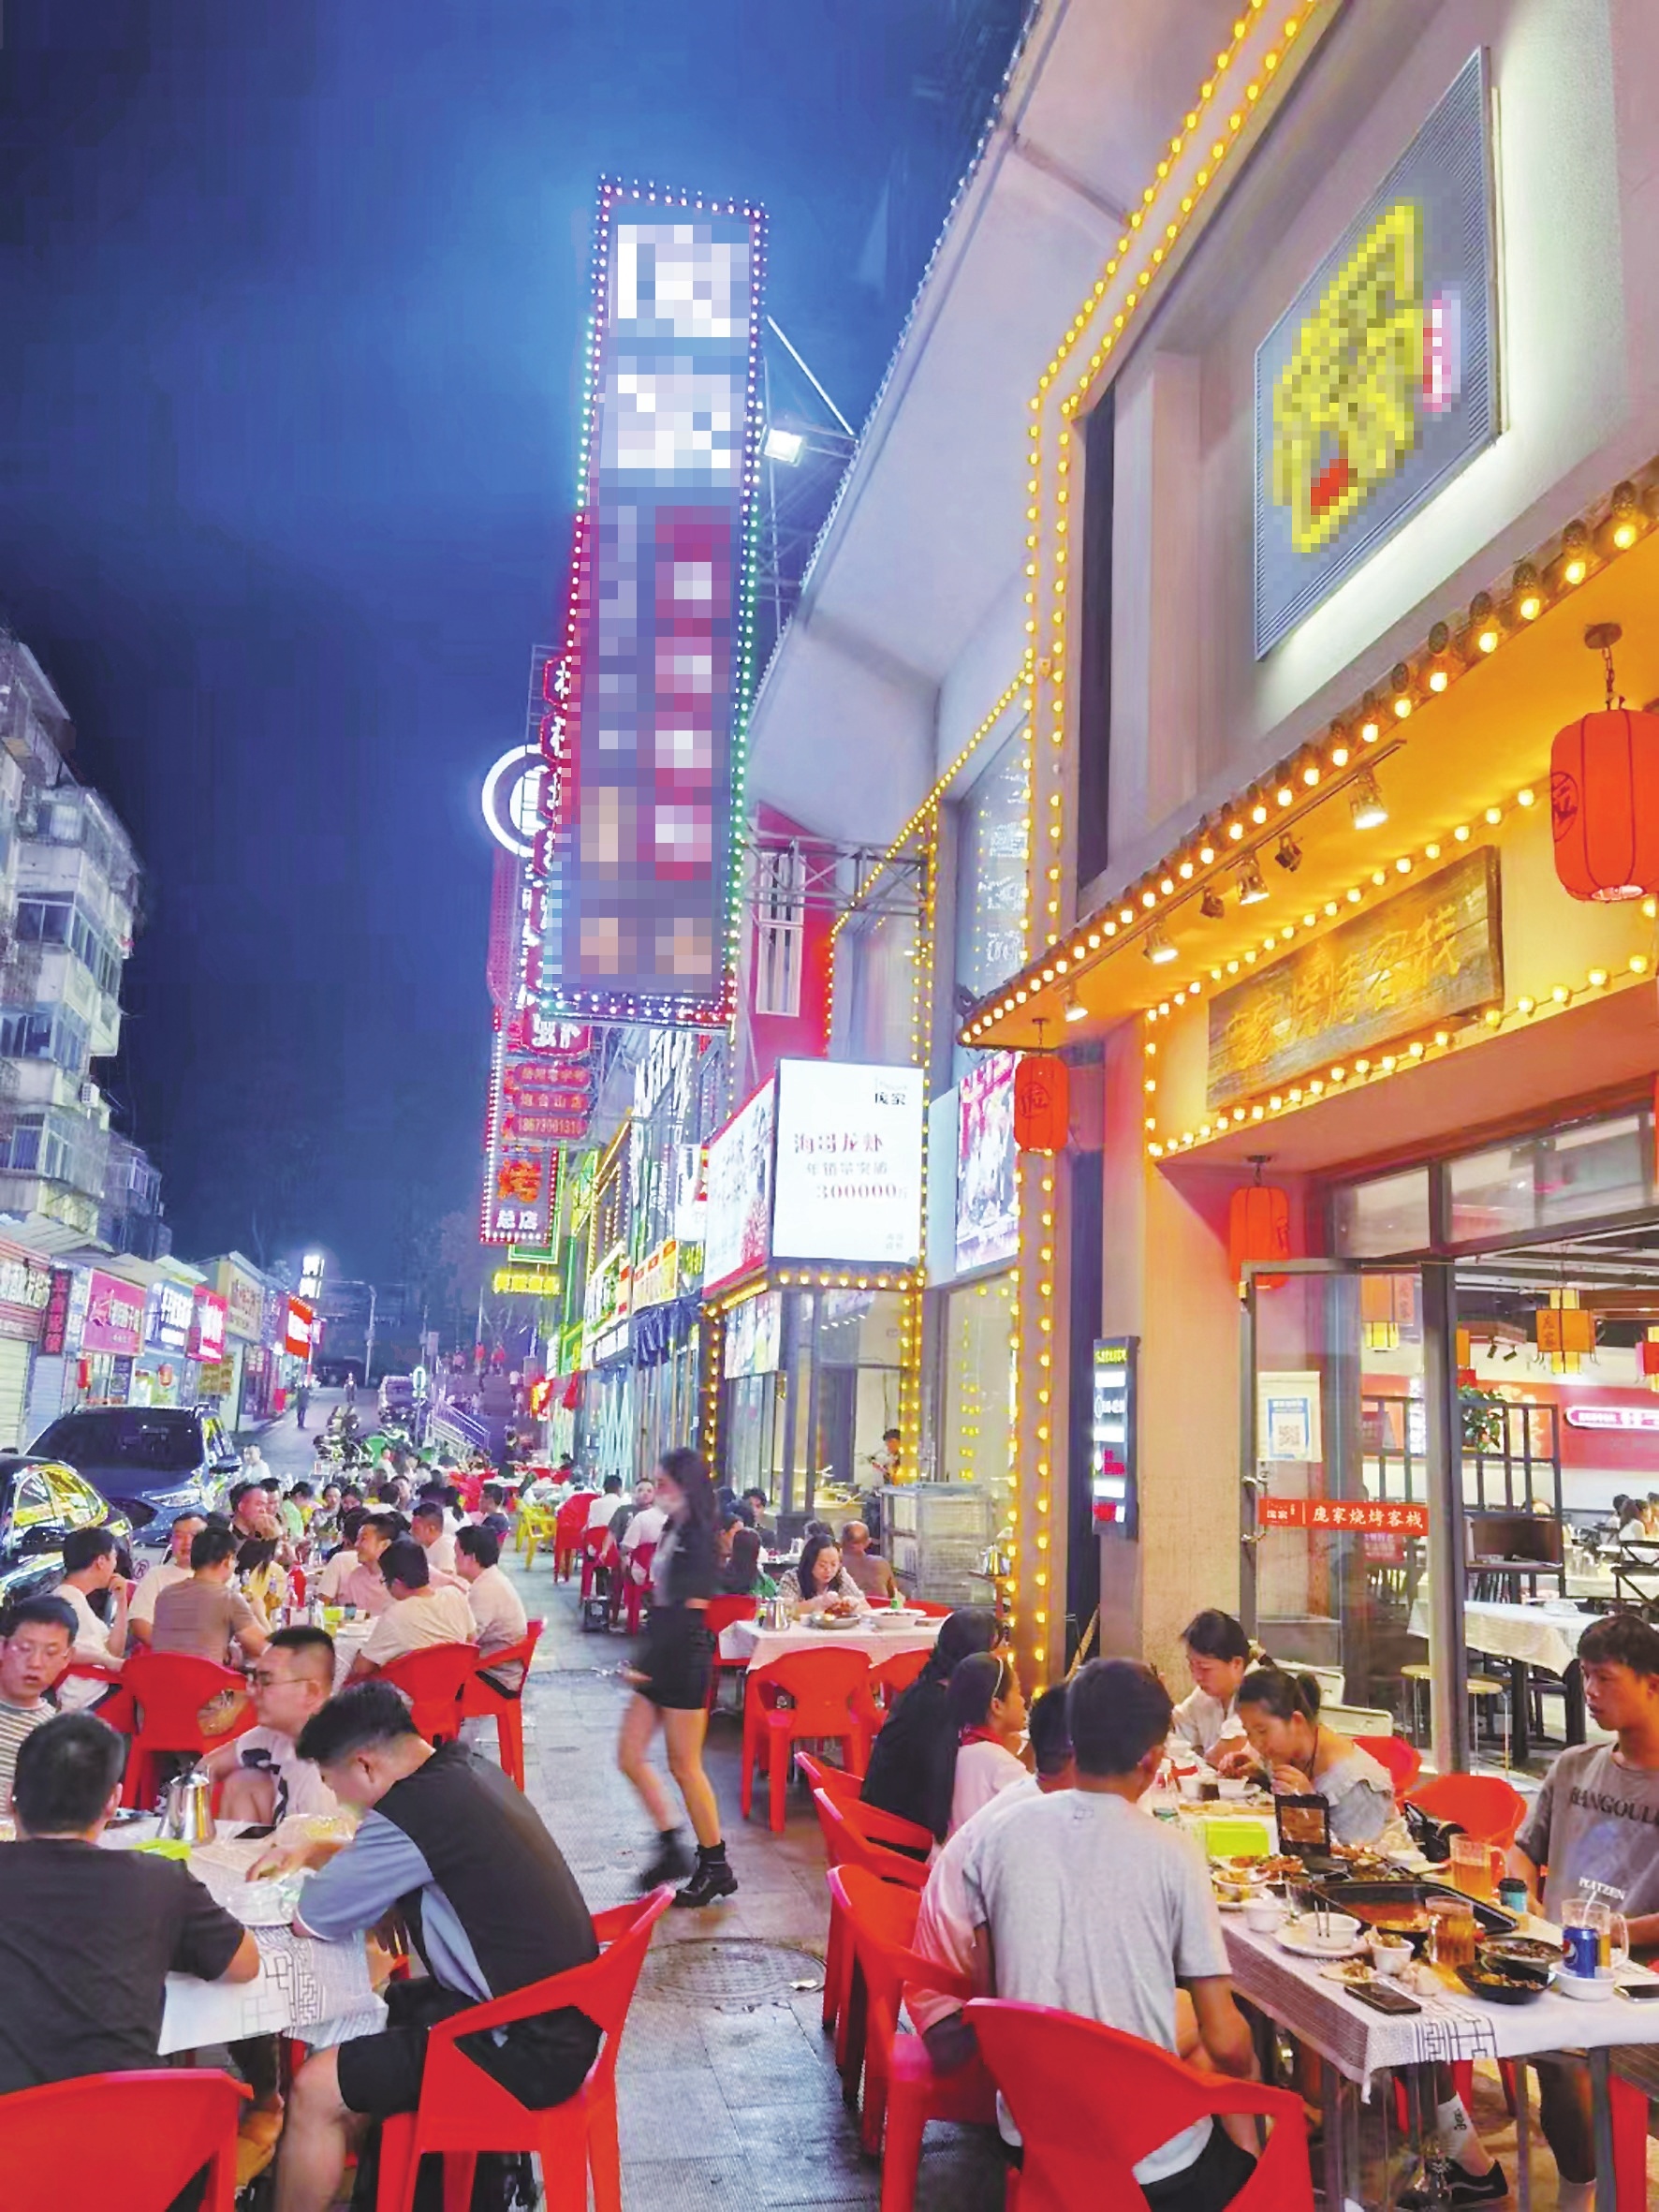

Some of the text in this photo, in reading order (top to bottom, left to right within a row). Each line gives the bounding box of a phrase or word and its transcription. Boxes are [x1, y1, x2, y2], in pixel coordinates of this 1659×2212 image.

[1313, 1505, 1423, 1529] 庞家烧烤客栈
